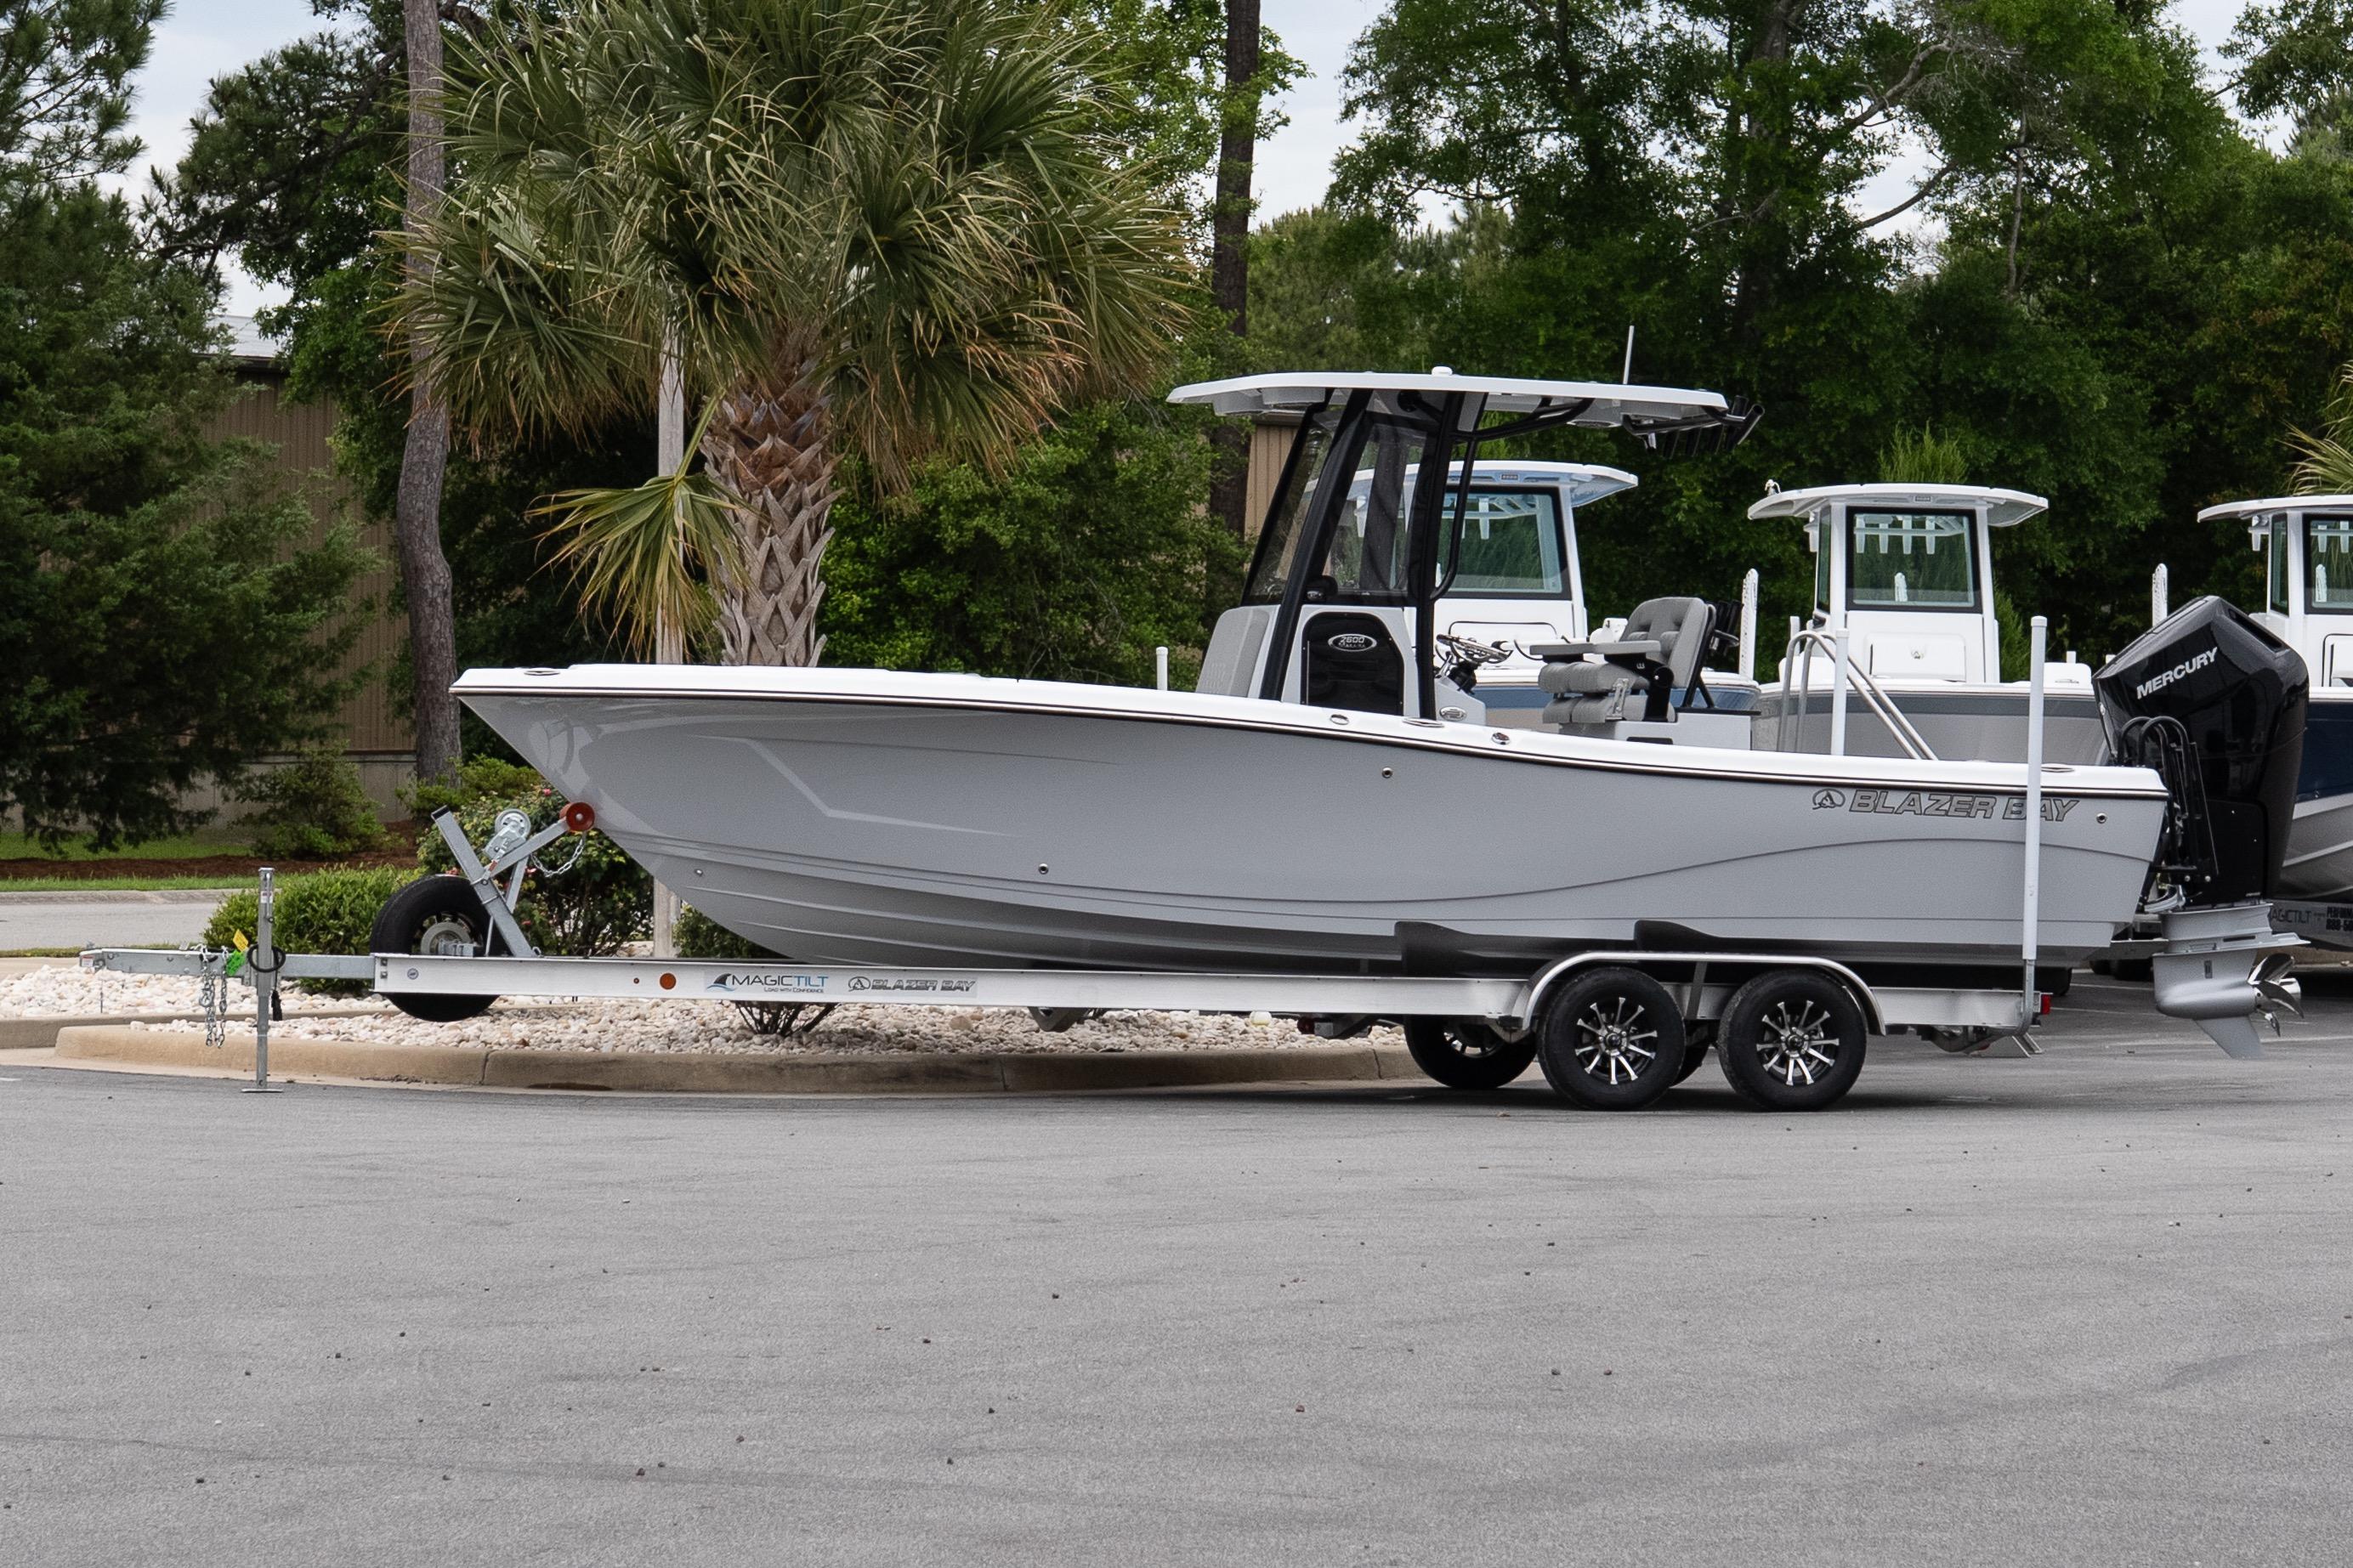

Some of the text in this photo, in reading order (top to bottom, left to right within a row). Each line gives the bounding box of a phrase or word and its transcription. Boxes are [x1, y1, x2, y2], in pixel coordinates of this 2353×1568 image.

[2136, 647, 2218, 699] MERCURY
[1849, 789, 2081, 822] BLAZER BAY
[731, 974, 829, 988] MAGICTILT
[870, 979, 976, 992] BLAZER BAY
